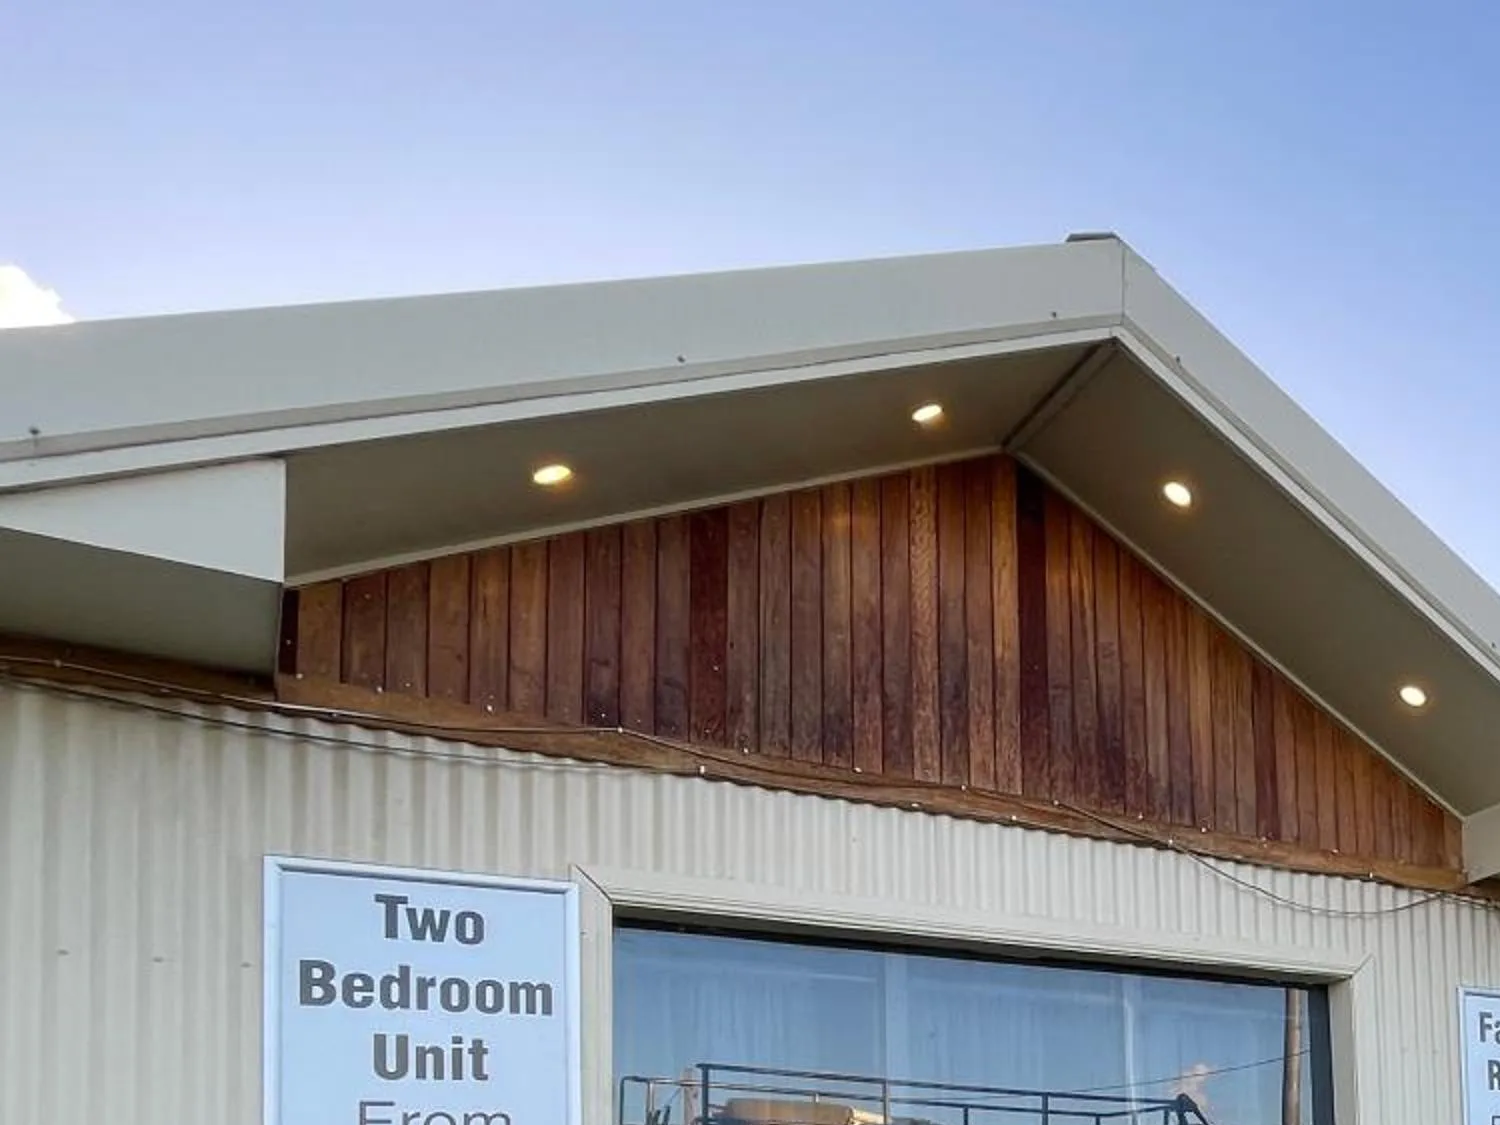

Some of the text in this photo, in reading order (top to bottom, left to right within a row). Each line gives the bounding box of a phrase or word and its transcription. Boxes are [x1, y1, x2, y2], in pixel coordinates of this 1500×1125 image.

[374, 893, 485, 945] Two
[299, 959, 553, 1016] Bedroom
[373, 1033, 489, 1081] Unit
